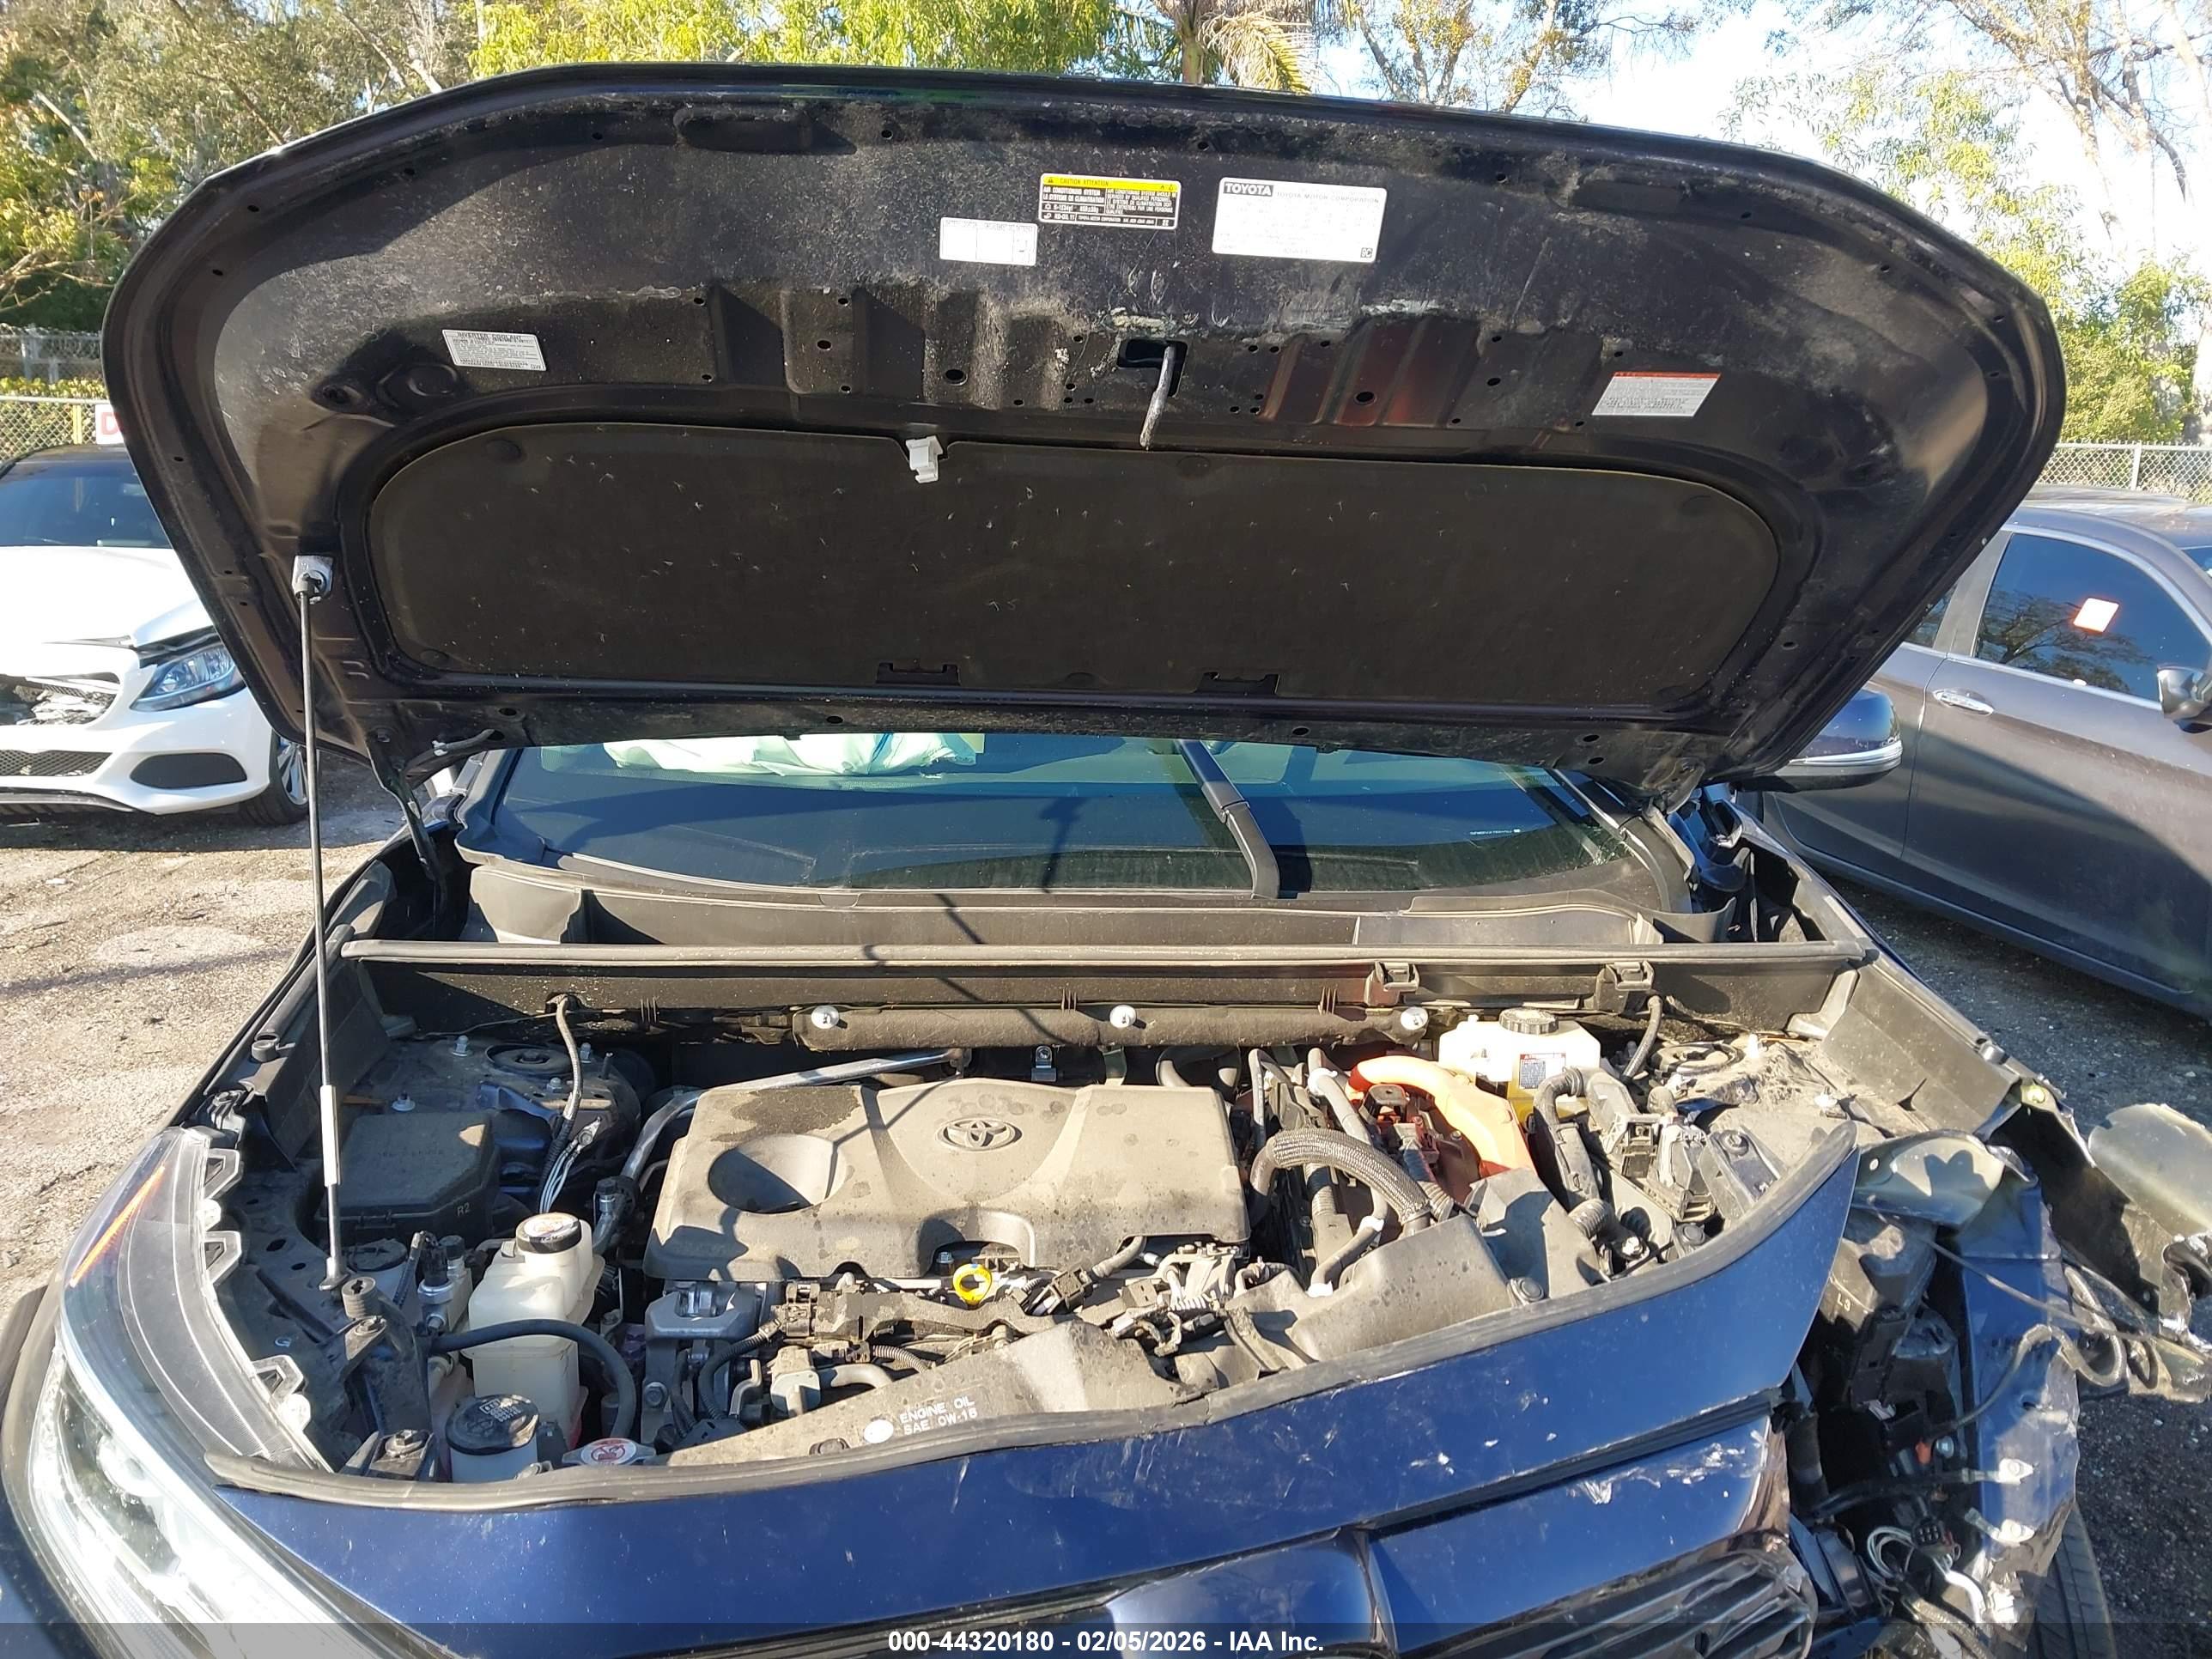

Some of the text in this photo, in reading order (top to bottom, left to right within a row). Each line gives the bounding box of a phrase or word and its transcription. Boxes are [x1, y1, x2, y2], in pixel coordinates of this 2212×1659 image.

[1225, 182, 1272, 196] TOYOTA
[457, 1203, 470, 1217] R2
[1837, 1293, 1851, 1312] L3
[899, 1395, 975, 1423] ENGINE OIL
[904, 1407, 978, 1435] SAE 0W-16
